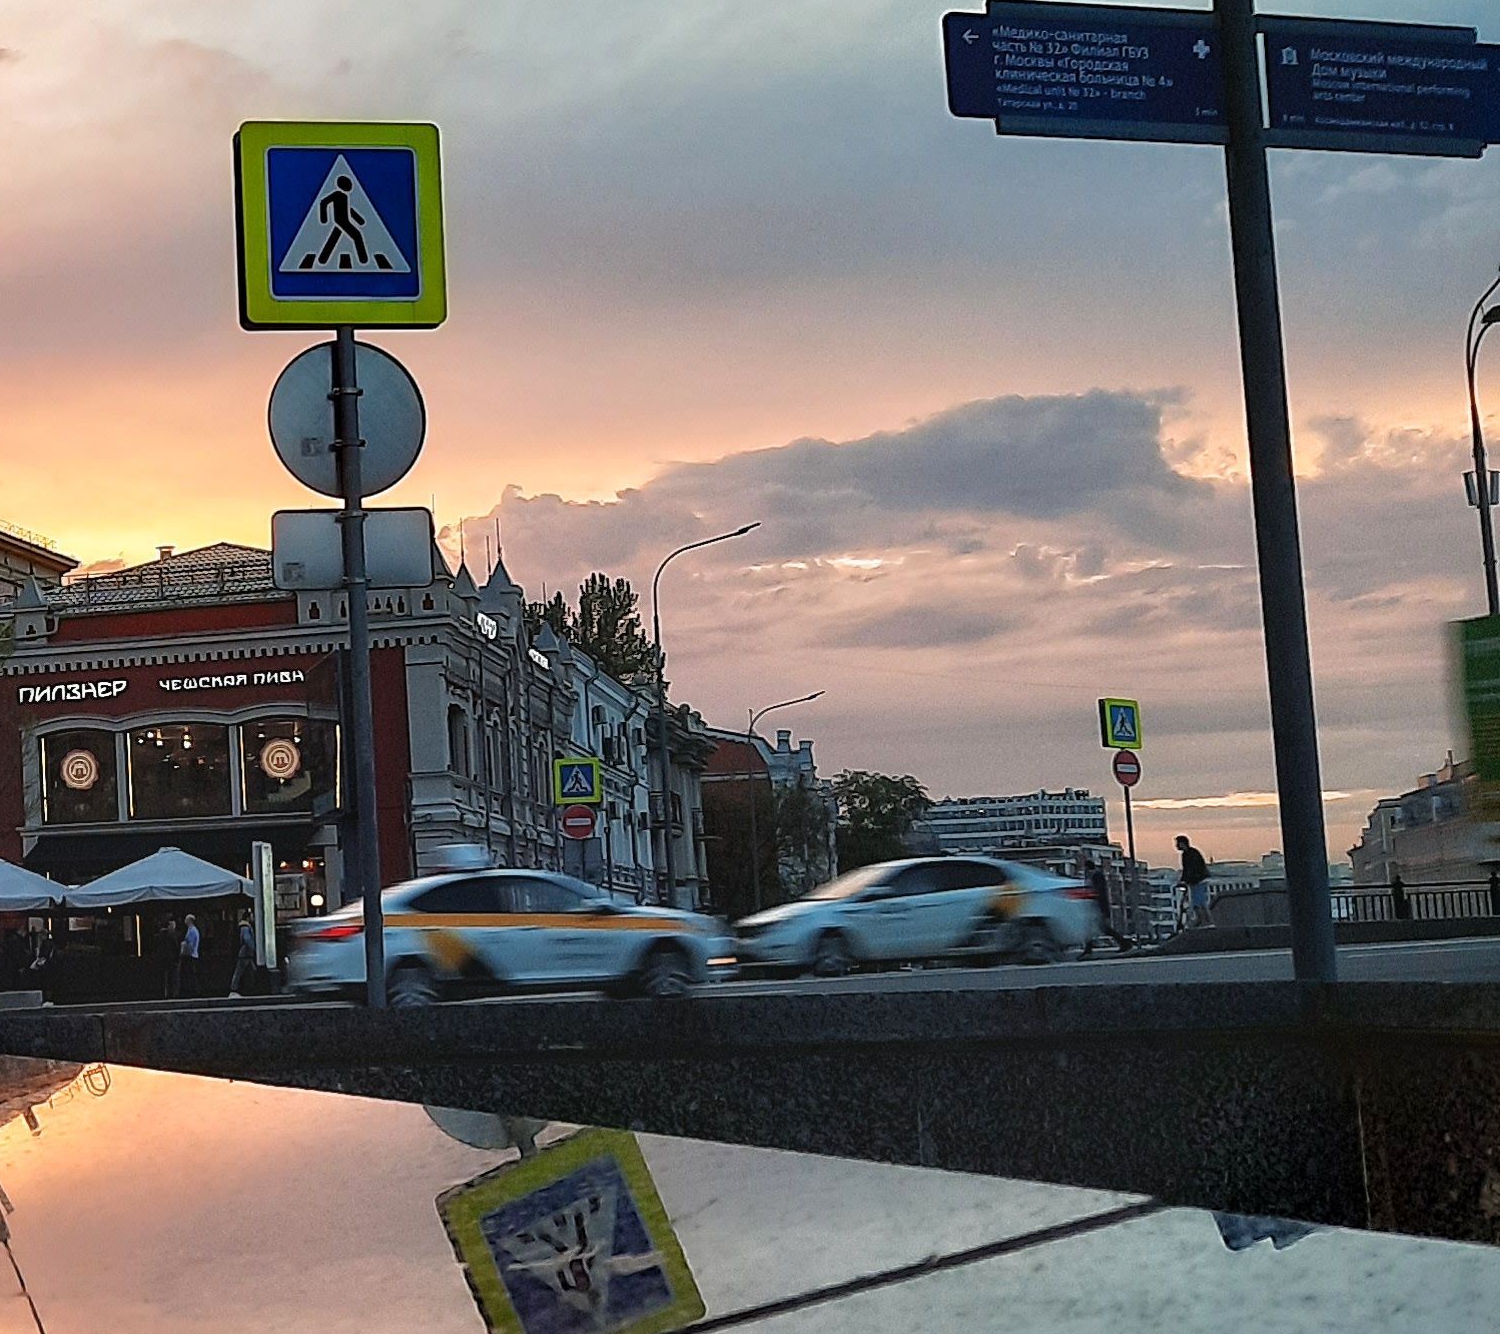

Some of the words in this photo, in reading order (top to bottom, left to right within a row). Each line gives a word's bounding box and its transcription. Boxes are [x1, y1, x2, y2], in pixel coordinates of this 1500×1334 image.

[1005, 53, 1055, 67] Москвы
[1122, 46, 1149, 59] ГБУЗ
[158, 673, 248, 692] ЧЕШСКАЯ
[18, 679, 128, 704] ПИЛЗНЕР
